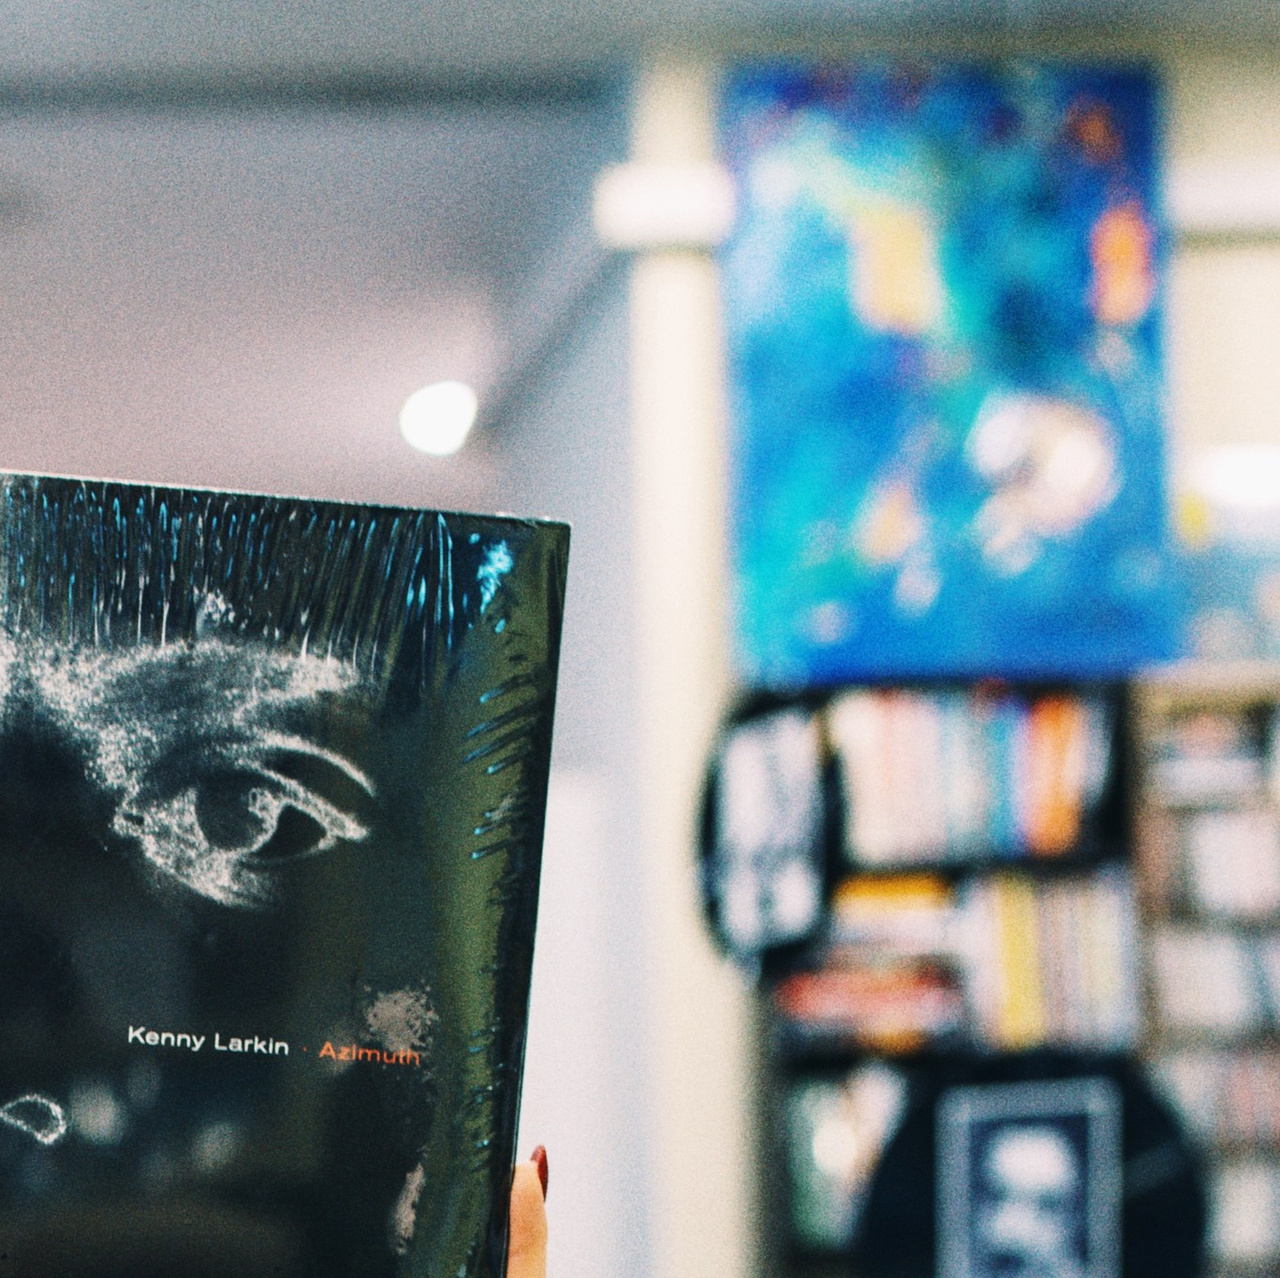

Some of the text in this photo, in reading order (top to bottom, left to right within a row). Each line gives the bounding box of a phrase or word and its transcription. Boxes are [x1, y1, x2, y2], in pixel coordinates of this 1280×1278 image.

[128, 1025, 421, 1066] Kenny Larkin Azimuth
